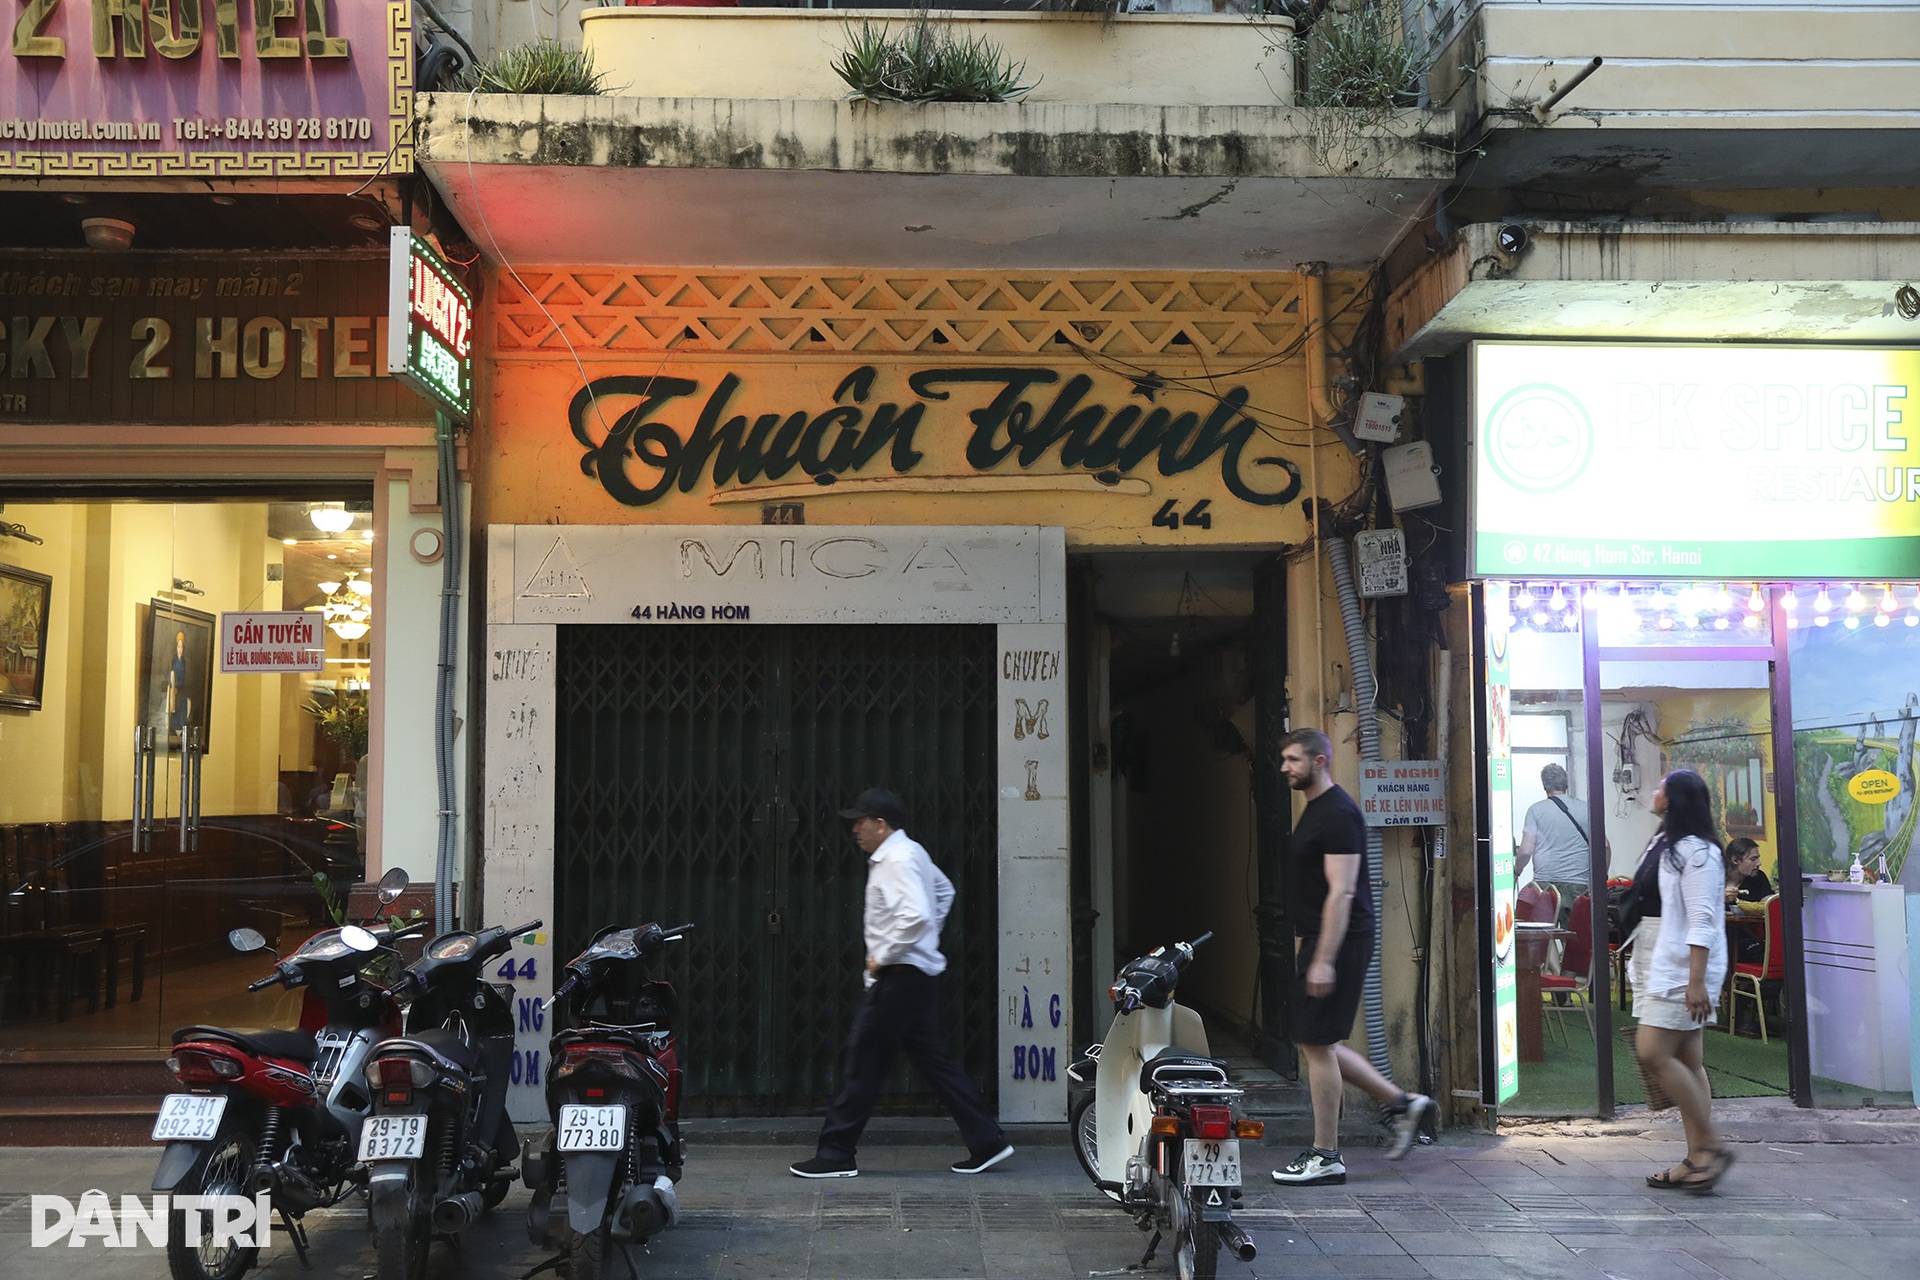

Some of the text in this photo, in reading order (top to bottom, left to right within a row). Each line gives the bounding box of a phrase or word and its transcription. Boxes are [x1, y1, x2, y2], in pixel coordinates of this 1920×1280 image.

[91, 0, 350, 59] HOTEL
[0, 118, 161, 141] ckyhotel.com.vn
[297, 118, 321, 140] 28
[326, 118, 371, 140] 8170
[147, 275, 208, 300] may
[284, 272, 303, 296] 2
[0, 316, 102, 379] KY
[130, 316, 172, 379] 2
[420, 330, 461, 398] HOTEL
[0, 393, 28, 413] TR
[1616, 382, 1908, 452] PK SPICE
[567, 365, 926, 507] Thuận
[771, 508, 794, 524] 44
[1152, 498, 1212, 530] 44
[1533, 544, 1552, 563] 42
[1555, 544, 1591, 568] Hang
[1595, 544, 1627, 564] Hom
[1661, 545, 1702, 565] Hanoi
[631, 605, 652, 620] 44
[656, 601, 706, 620] HÀNG
[233, 616, 313, 645] CẦN TUYỂN
[1394, 768, 1439, 781] NGHỊ
[1861, 779, 1889, 789] OPEN
[1379, 799, 1391, 813] XE
[497, 957, 537, 981] 44
[518, 997, 544, 1033] NG
[510, 1050, 540, 1086] OM
[1013, 1045, 1056, 1082] HOM
[1183, 1059, 1213, 1067] HONDA
[169, 1097, 216, 1116] 29-H1
[158, 1117, 215, 1137] 992.32
[370, 1118, 419, 1138] 29-T9
[570, 1108, 614, 1127] 29-C1
[367, 1137, 415, 1157] 8372
[564, 1129, 619, 1148] 773.80
[1204, 1143, 1220, 1162] 29
